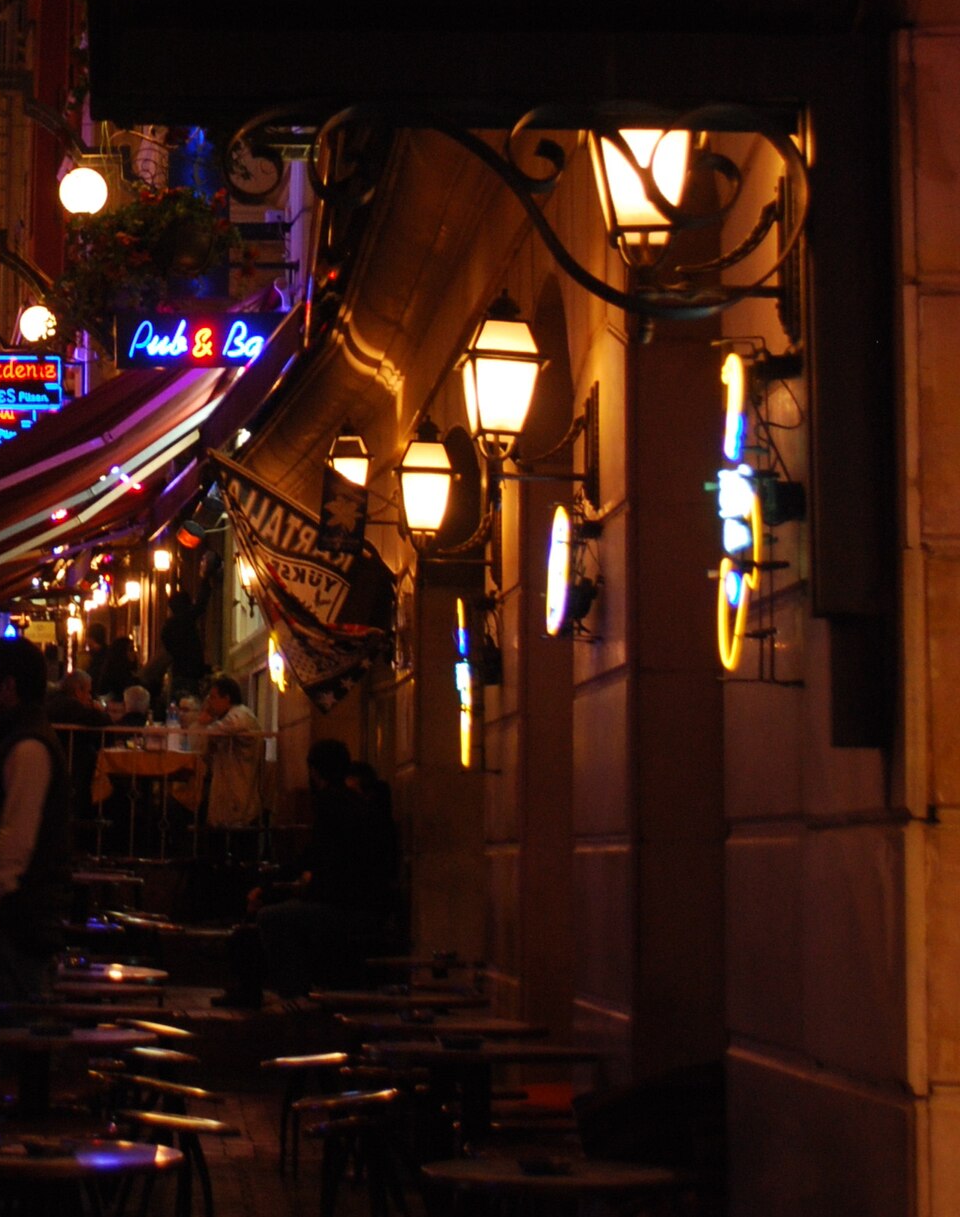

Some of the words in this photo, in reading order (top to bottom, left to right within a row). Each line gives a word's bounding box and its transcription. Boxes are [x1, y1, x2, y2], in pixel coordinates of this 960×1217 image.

[128, 318, 188, 359] Pub
[191, 327, 213, 359] &
[222, 320, 265, 359] Ba
[18, 392, 50, 404] Pilsen
